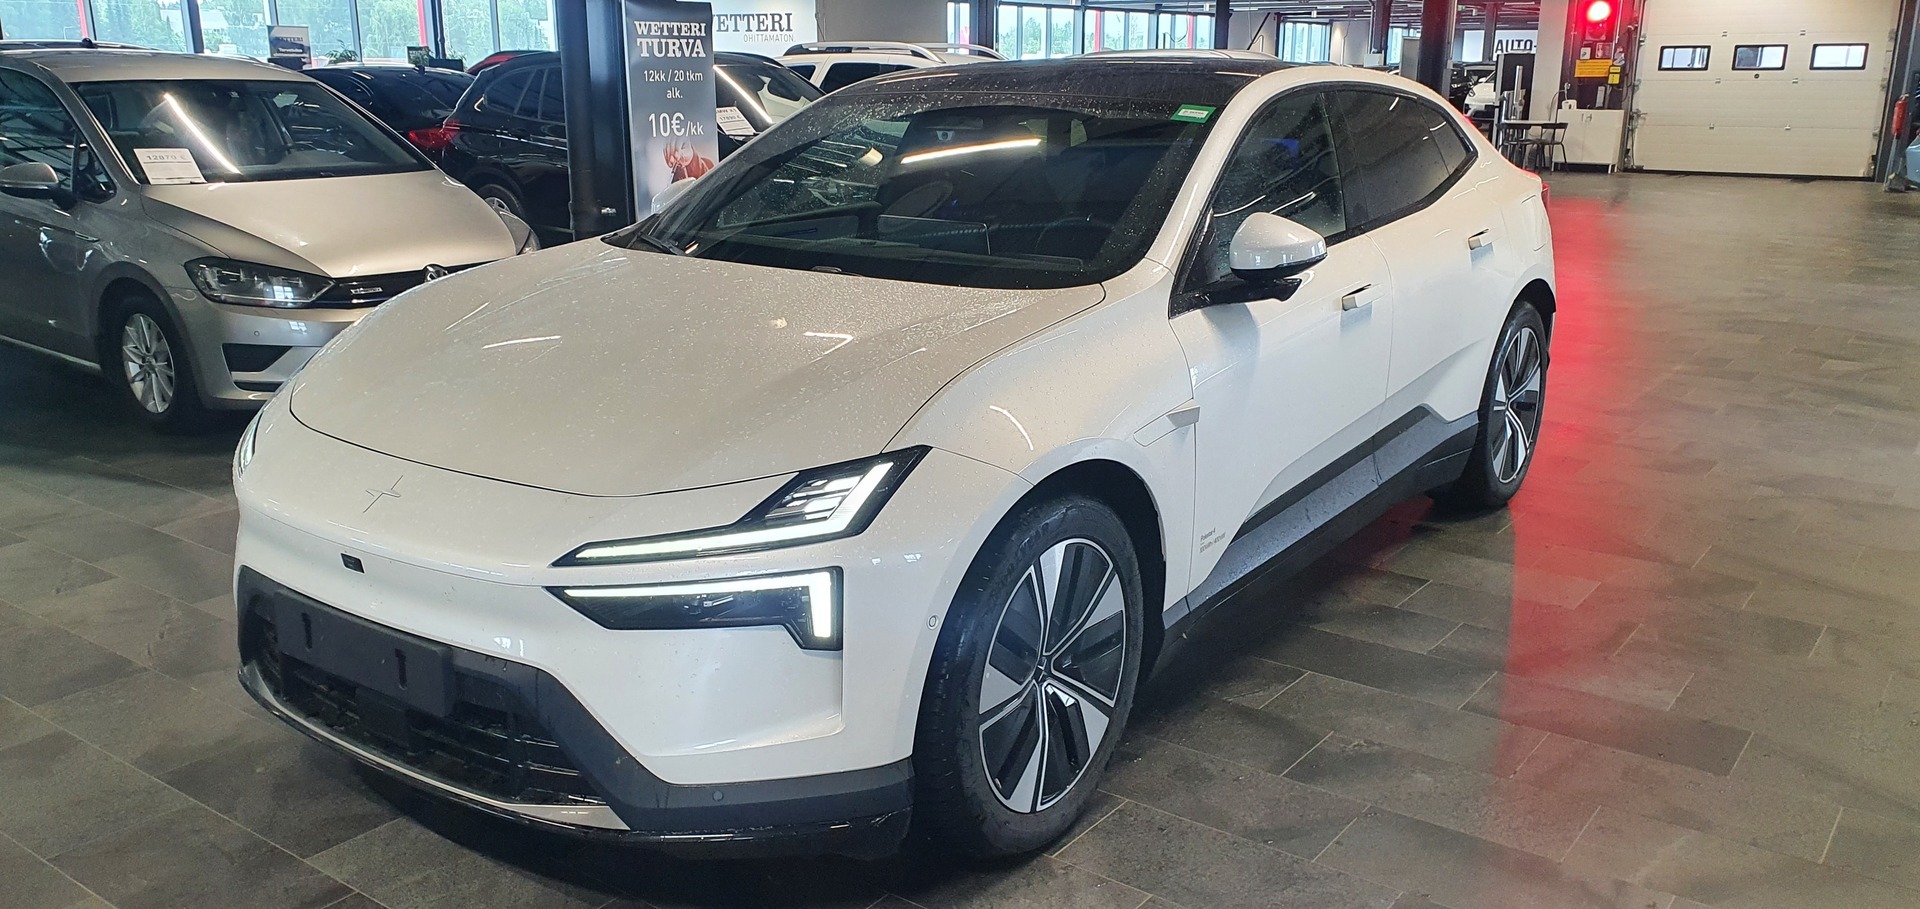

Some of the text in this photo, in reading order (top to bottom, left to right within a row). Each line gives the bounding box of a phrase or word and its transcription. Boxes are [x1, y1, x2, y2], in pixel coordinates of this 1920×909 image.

[633, 21, 707, 36] WETTERI
[713, 13, 793, 32] ETTERI
[743, 34, 796, 42] OHITTAMATON.
[636, 38, 707, 58] TURVA
[643, 69, 704, 83] 12kk / 20 tkm
[666, 87, 683, 99] alk.
[648, 112, 704, 138] 10€/kk
